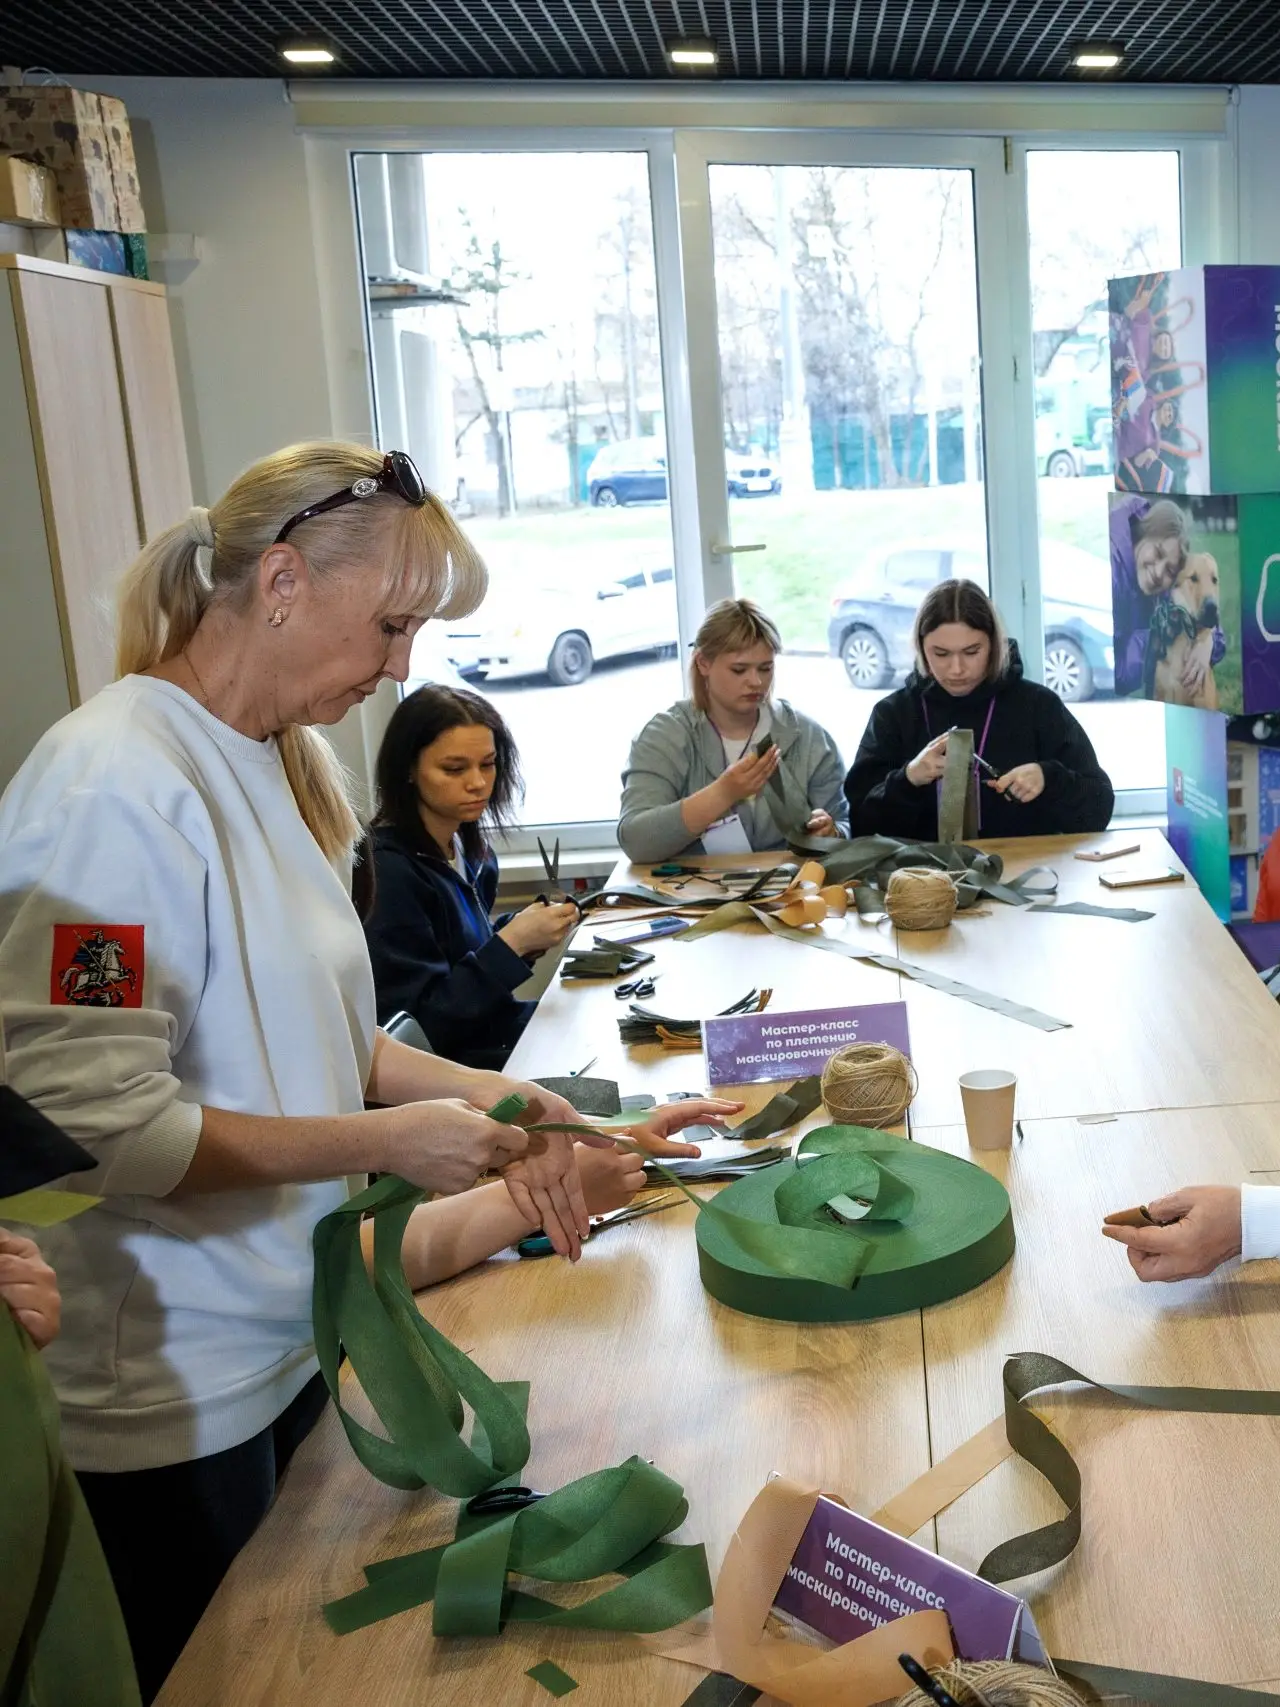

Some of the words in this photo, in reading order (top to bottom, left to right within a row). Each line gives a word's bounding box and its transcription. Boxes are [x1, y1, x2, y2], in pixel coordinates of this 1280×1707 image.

[761, 1018, 860, 1037] Мастер-класс
[766, 1038, 782, 1049] по
[785, 1032, 857, 1047] плетению
[736, 1046, 841, 1065] маскировочны
[825, 1531, 946, 1610] Мастер-класс
[824, 1560, 844, 1581] по
[846, 1572, 916, 1617] плетен
